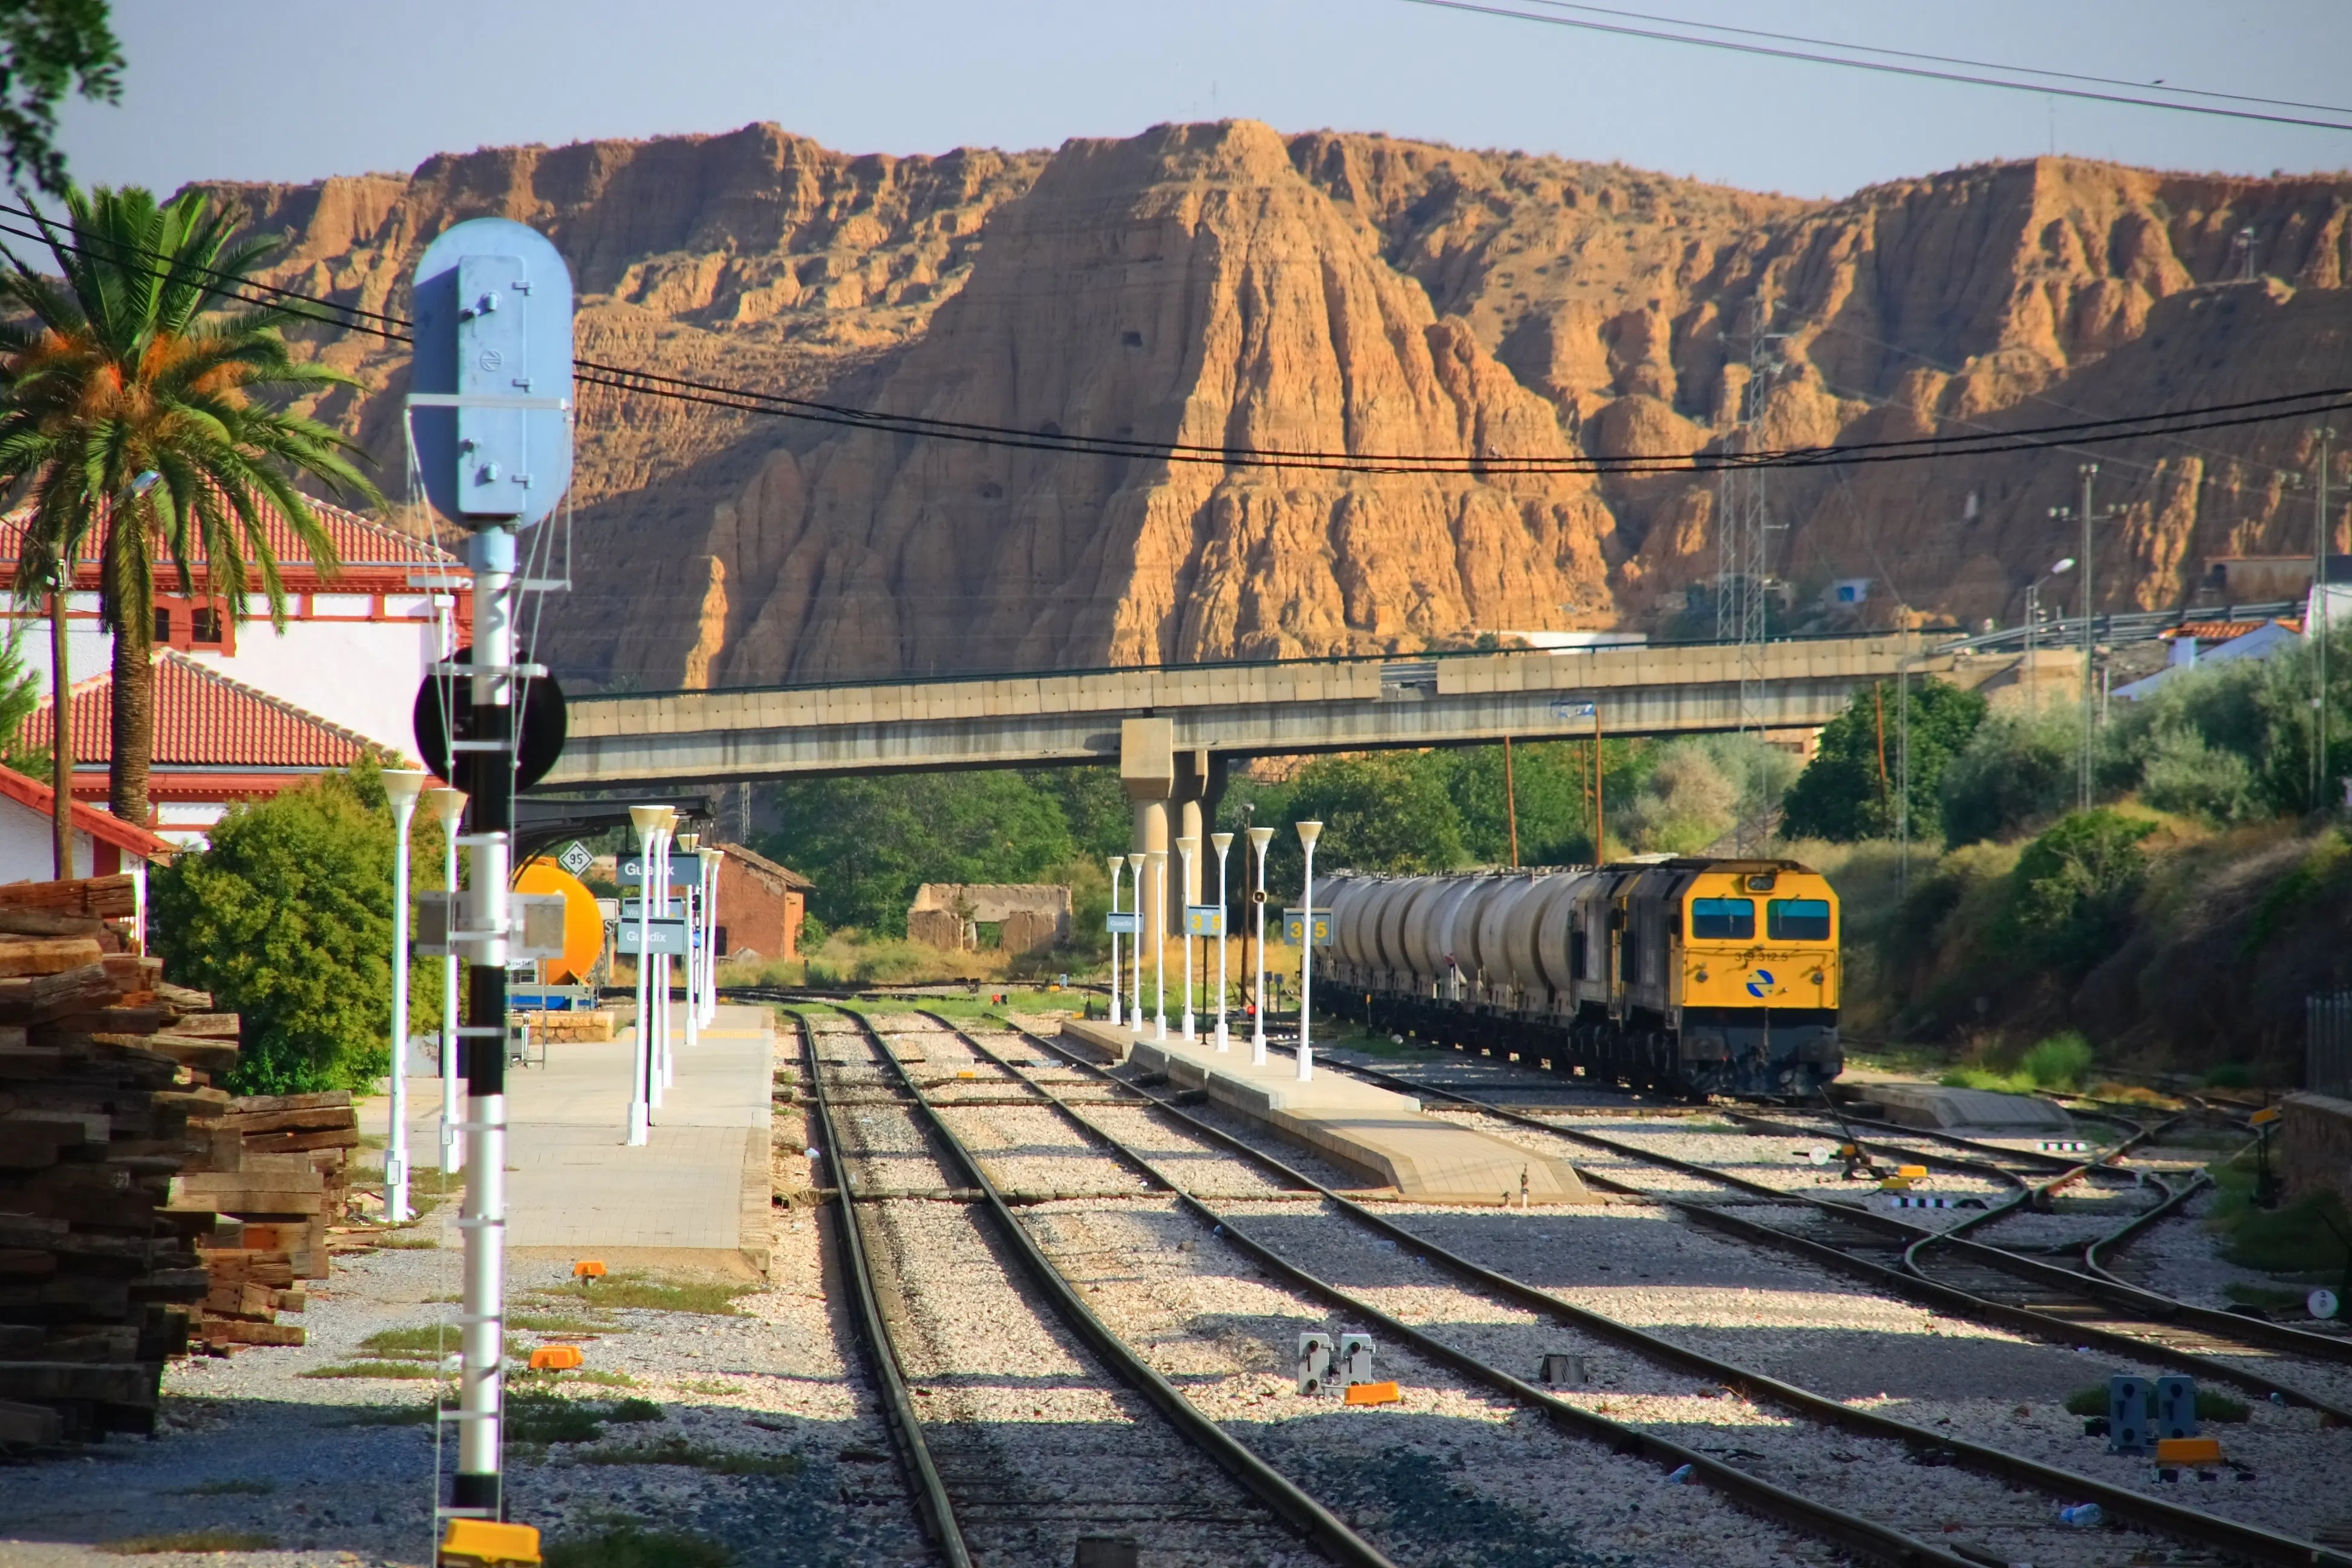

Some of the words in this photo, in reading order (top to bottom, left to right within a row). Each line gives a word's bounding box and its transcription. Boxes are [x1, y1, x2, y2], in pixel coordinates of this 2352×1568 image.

[570, 854, 583, 864] 95
[1192, 914, 1202, 929] 3
[1290, 921, 1303, 938] 3
[1315, 921, 1327, 938] 5
